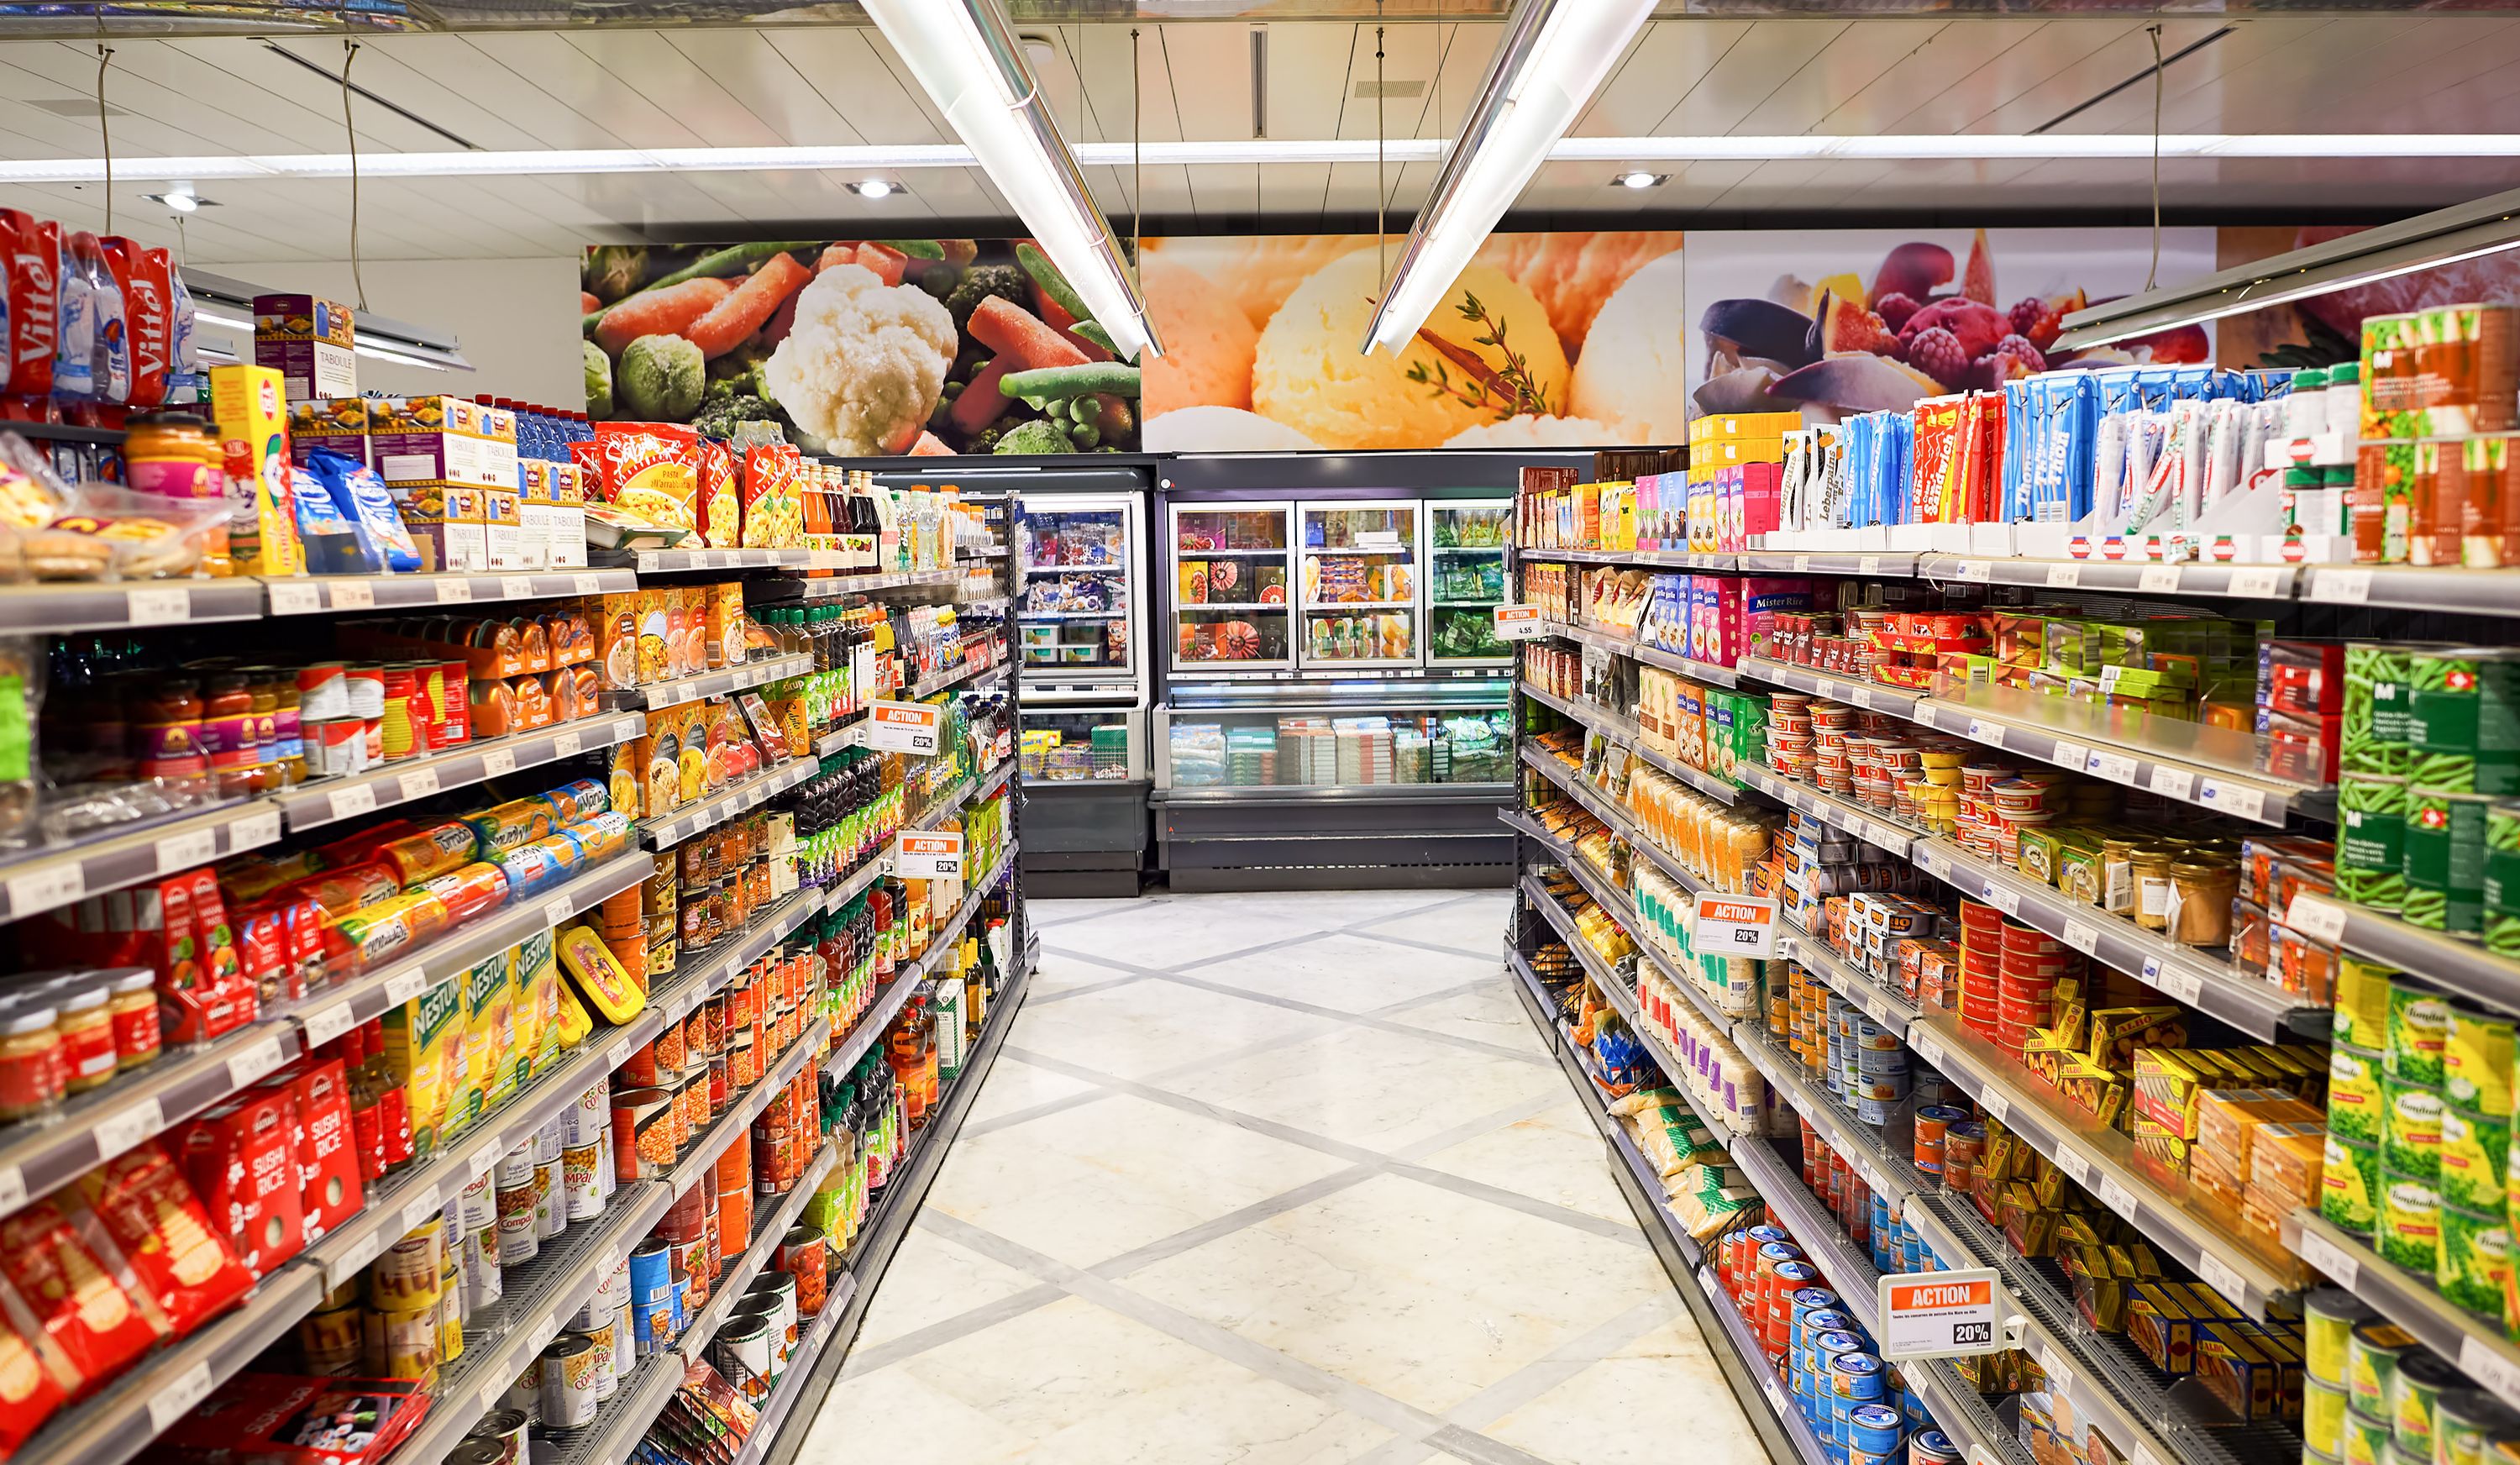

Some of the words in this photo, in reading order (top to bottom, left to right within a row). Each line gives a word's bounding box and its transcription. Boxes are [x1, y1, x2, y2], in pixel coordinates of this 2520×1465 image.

[19, 254, 54, 362] Vittel
[129, 279, 164, 376] Vittel
[1819, 449, 1836, 522] Leberpains
[1756, 598, 1786, 609] Mister
[1506, 610, 1530, 619] ACTION
[783, 680, 805, 692] sirup
[2375, 683, 2395, 701] M
[785, 701, 801, 730] Subito
[887, 710, 922, 723] ACTION
[914, 737, 932, 747] 20%
[1998, 798, 2025, 806] Malbuner
[913, 840, 947, 851] ACTION
[1786, 850, 1798, 866] RIO
[937, 862, 957, 871] 20%
[1756, 864, 1769, 880] RIO
[1785, 885, 1798, 902] RIO
[1714, 904, 1756, 921] ACTION
[1854, 899, 1865, 910] RIO
[1872, 911, 1883, 923] RIO
[1736, 930, 1757, 943] 20%
[515, 927, 554, 985] NESTUM
[465, 950, 511, 1011] NESTUM
[412, 976, 462, 1044] NESTUM
[2118, 1015, 2153, 1034] ALBO
[2029, 1040, 2045, 1048] ALBO
[2065, 1065, 2082, 1074] ALBO
[2142, 1063, 2161, 1073] ALBO
[311, 1110, 341, 1140] SUSHI
[2141, 1125, 2162, 1134] ALBO
[316, 1130, 343, 1159] RICE
[252, 1145, 286, 1178] SUSHI
[256, 1166, 286, 1198] RICE
[501, 1211, 533, 1228] Compal
[1912, 1285, 1971, 1307] ACTION
[2133, 1300, 2150, 1311] ALBO
[1956, 1324, 1989, 1342] 20%
[2204, 1341, 2225, 1353] ALBO
[2025, 1362, 2043, 1374] ALBO
